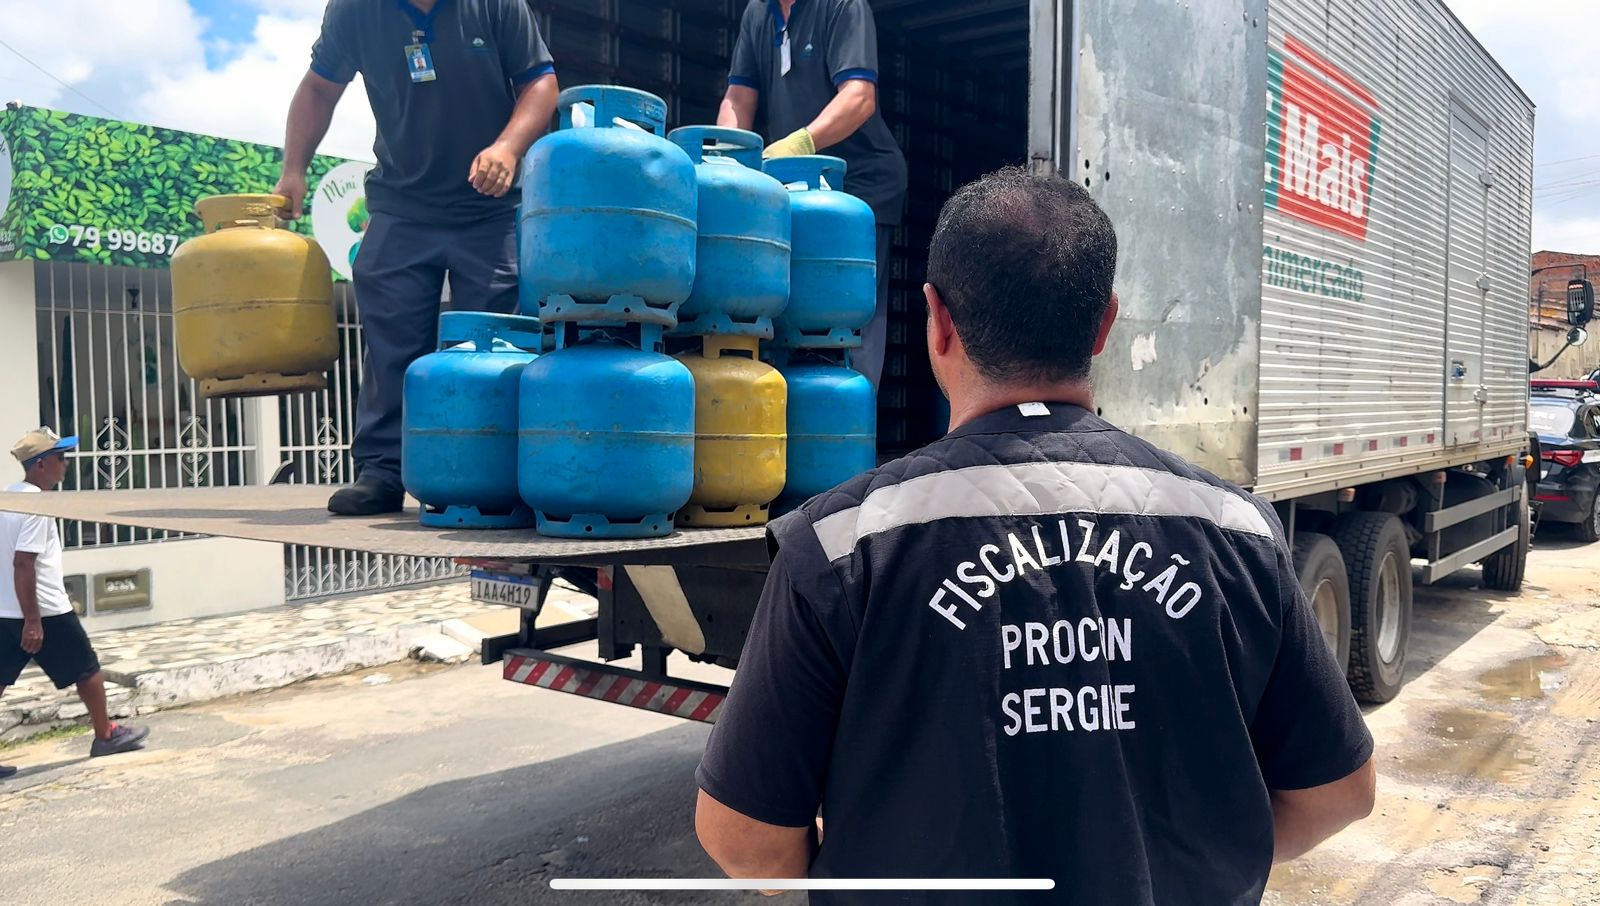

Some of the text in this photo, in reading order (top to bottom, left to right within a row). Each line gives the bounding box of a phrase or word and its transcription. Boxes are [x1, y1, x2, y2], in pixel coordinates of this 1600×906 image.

[1283, 101, 1365, 218] Mais
[321, 175, 357, 204] Mini
[69, 224, 179, 255] 79 99687
[477, 581, 531, 605] IAA4H19
[928, 519, 1202, 631] FISCALIZAÇÃO
[1002, 617, 1132, 669] PROCN
[1002, 684, 1136, 736] SERGIE
